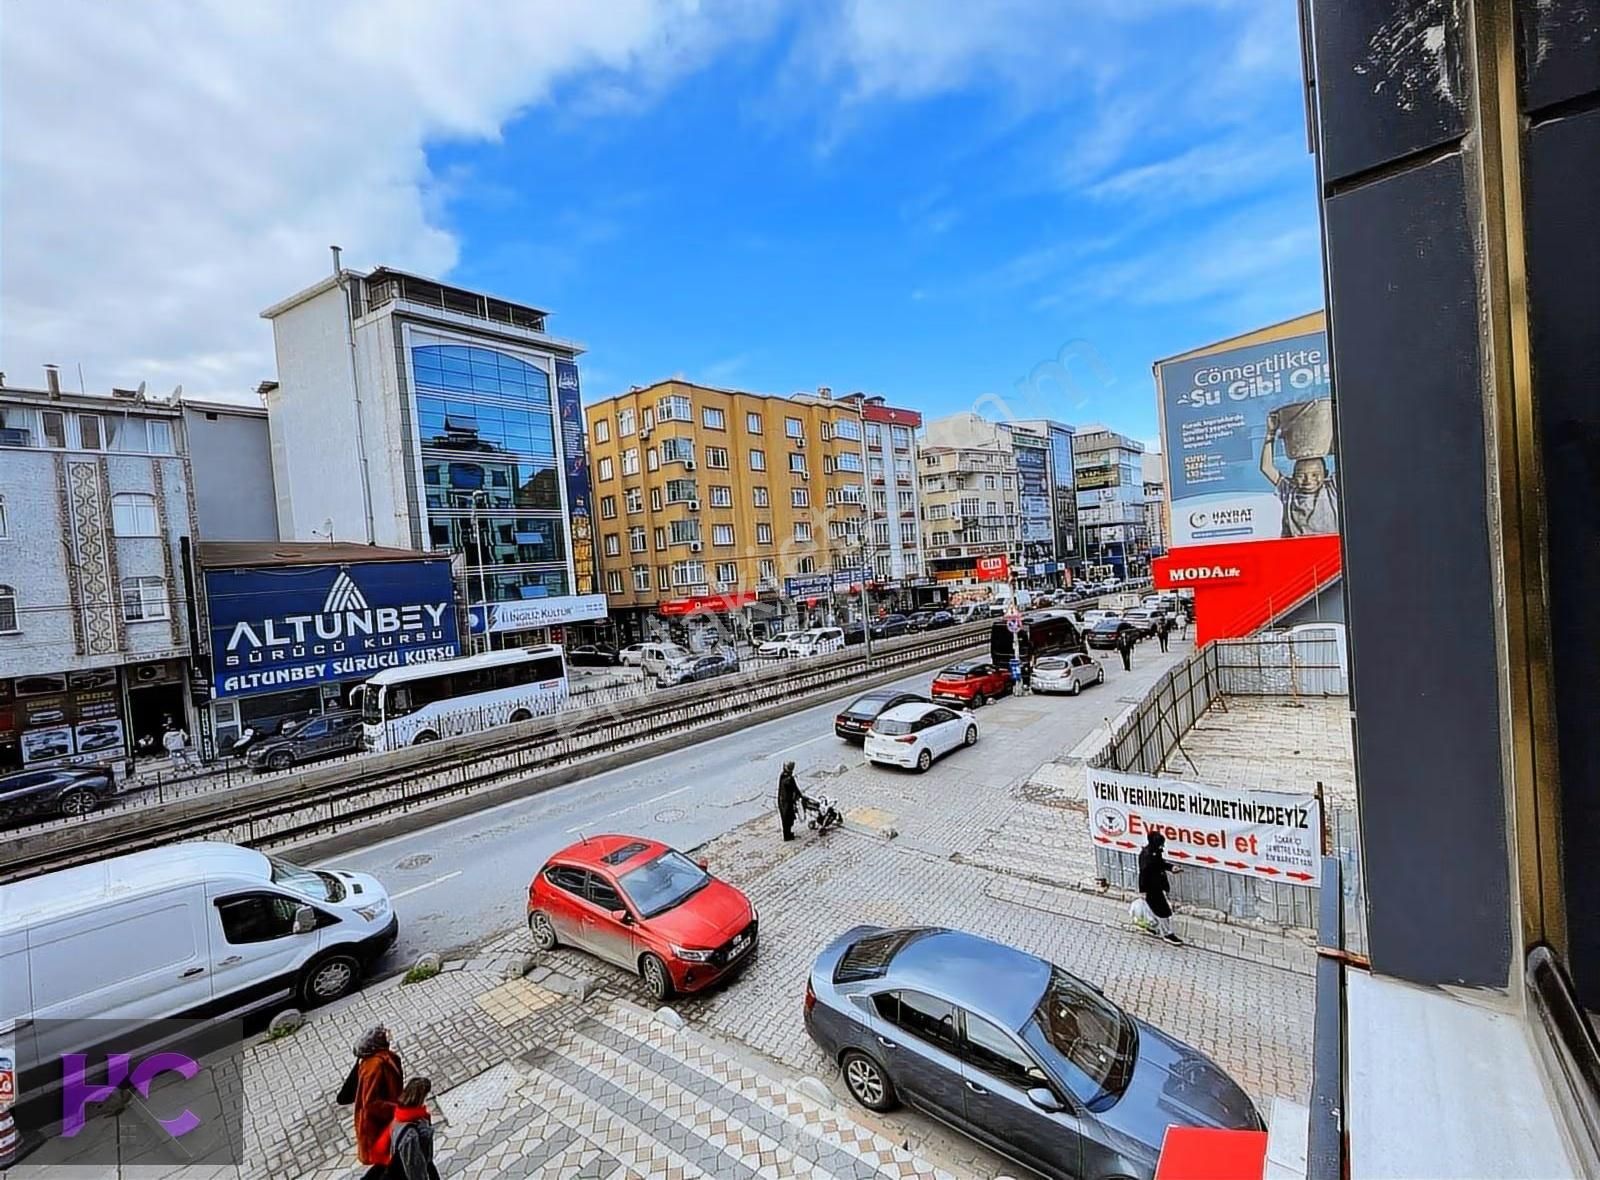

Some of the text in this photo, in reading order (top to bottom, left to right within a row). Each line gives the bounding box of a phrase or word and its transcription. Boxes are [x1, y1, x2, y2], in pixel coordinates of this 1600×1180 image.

[1194, 350, 1321, 386] Cömertlikte
[1190, 389, 1221, 408] Su
[1228, 373, 1282, 400] Gibi
[1212, 508, 1252, 520] HAYRAT
[226, 602, 448, 651] ALTUNBEY
[224, 664, 326, 691] ALTUNBEY
[405, 645, 456, 665] KURSU
[225, 630, 443, 666] SÜRÜCÜ KURSU
[1093, 781, 1309, 829] YENİ YERİMİZDE HİZMETİNİZDEYİZ
[1128, 812, 1226, 849] Evrensel
[1235, 834, 1258, 856] et
